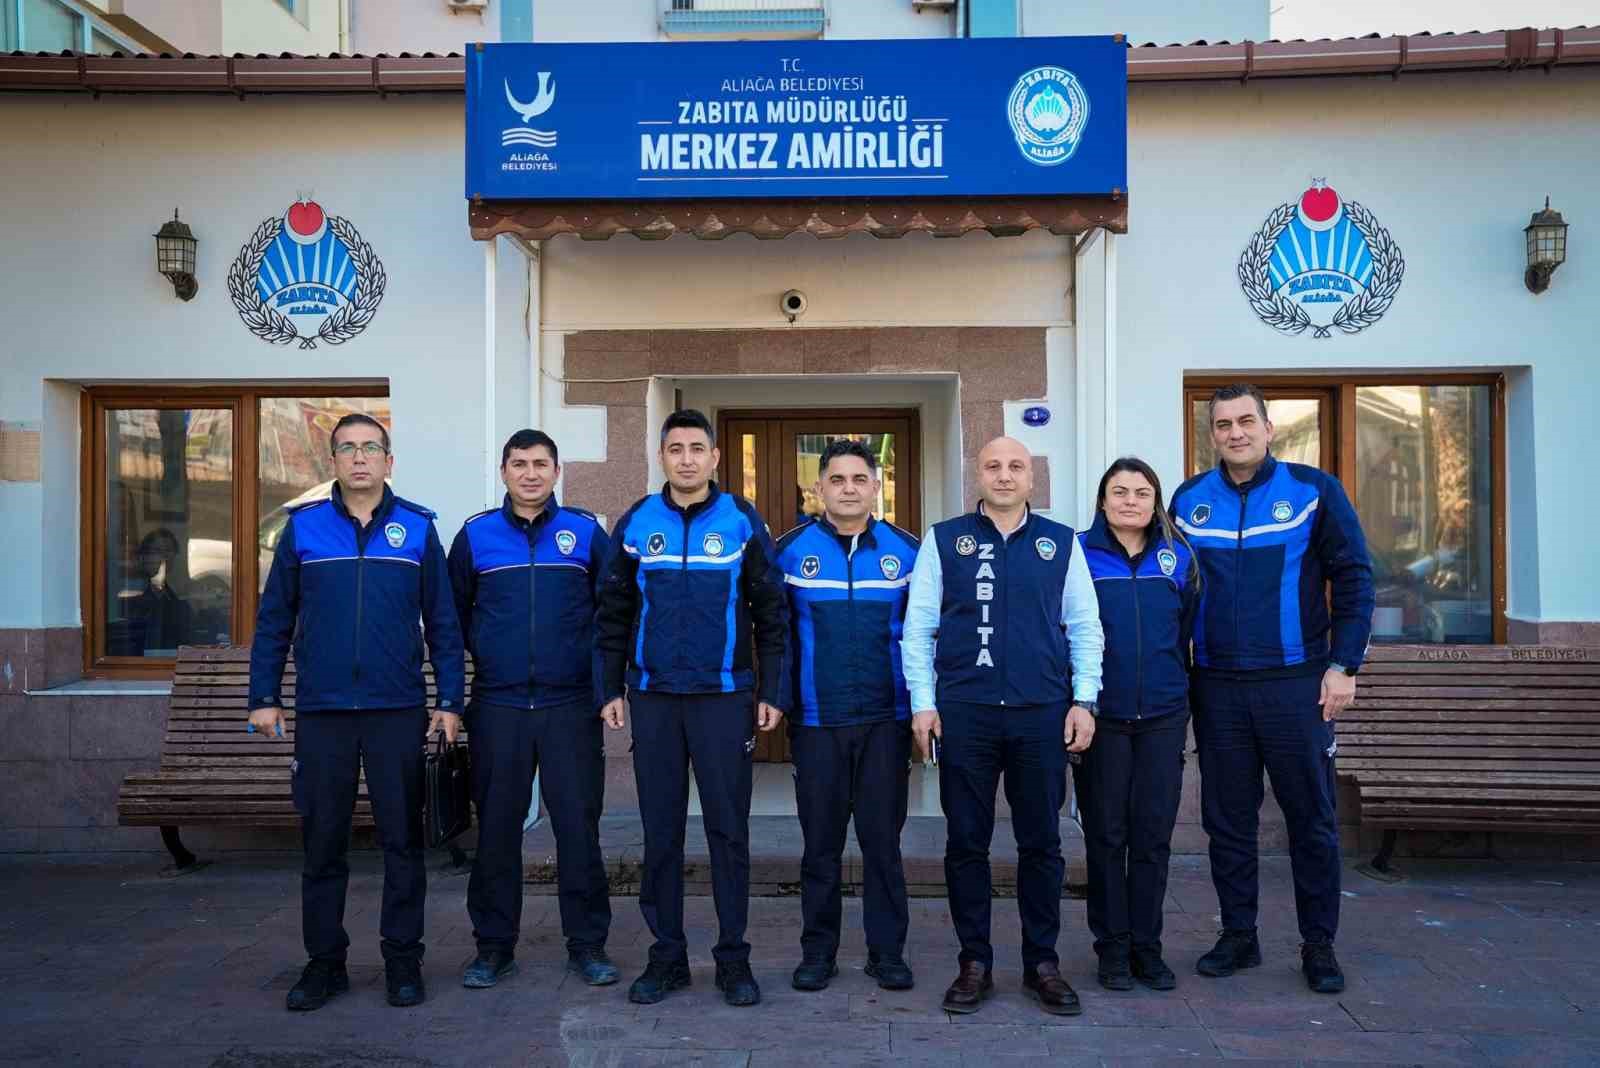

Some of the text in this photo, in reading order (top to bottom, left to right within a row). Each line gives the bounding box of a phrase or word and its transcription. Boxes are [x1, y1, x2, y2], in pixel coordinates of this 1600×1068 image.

[780, 58, 805, 73] T.C.
[678, 96, 908, 124] ZABITA MÜDÜRLÜĞÜ
[640, 125, 944, 170] MERKEZ AMİRLİĞİ
[976, 543, 995, 667] ZABITA
